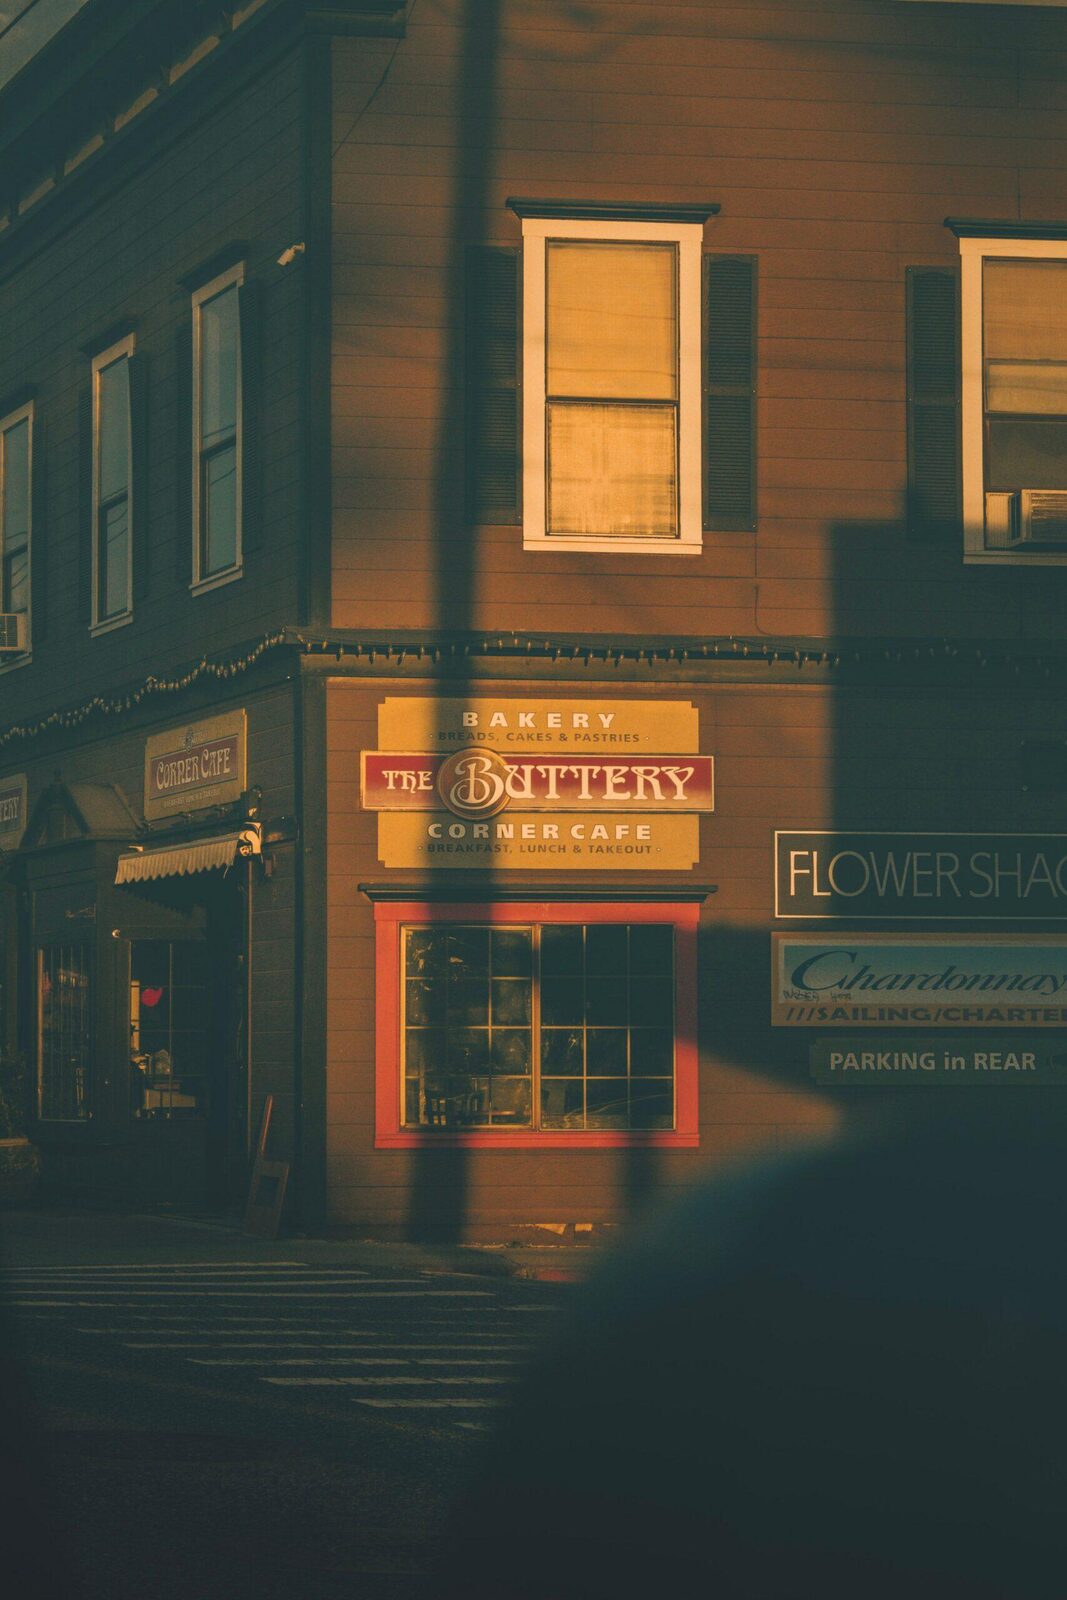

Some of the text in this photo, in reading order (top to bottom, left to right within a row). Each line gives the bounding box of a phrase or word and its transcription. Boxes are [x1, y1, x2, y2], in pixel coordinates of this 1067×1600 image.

[463, 712, 616, 728] BAKERY
[438, 732, 640, 743] BREADS, CAKES & PASTRIES
[156, 748, 231, 790] CORNER CAFE
[428, 823, 652, 840] CORNER CAFE
[427, 843, 652, 855] BREAKFAST, LUNCH & TAKEOUT
[790, 851, 962, 897] FLOWER
[791, 951, 1067, 996] Chardonnay
[830, 1052, 1037, 1071] PARKING in REAR
